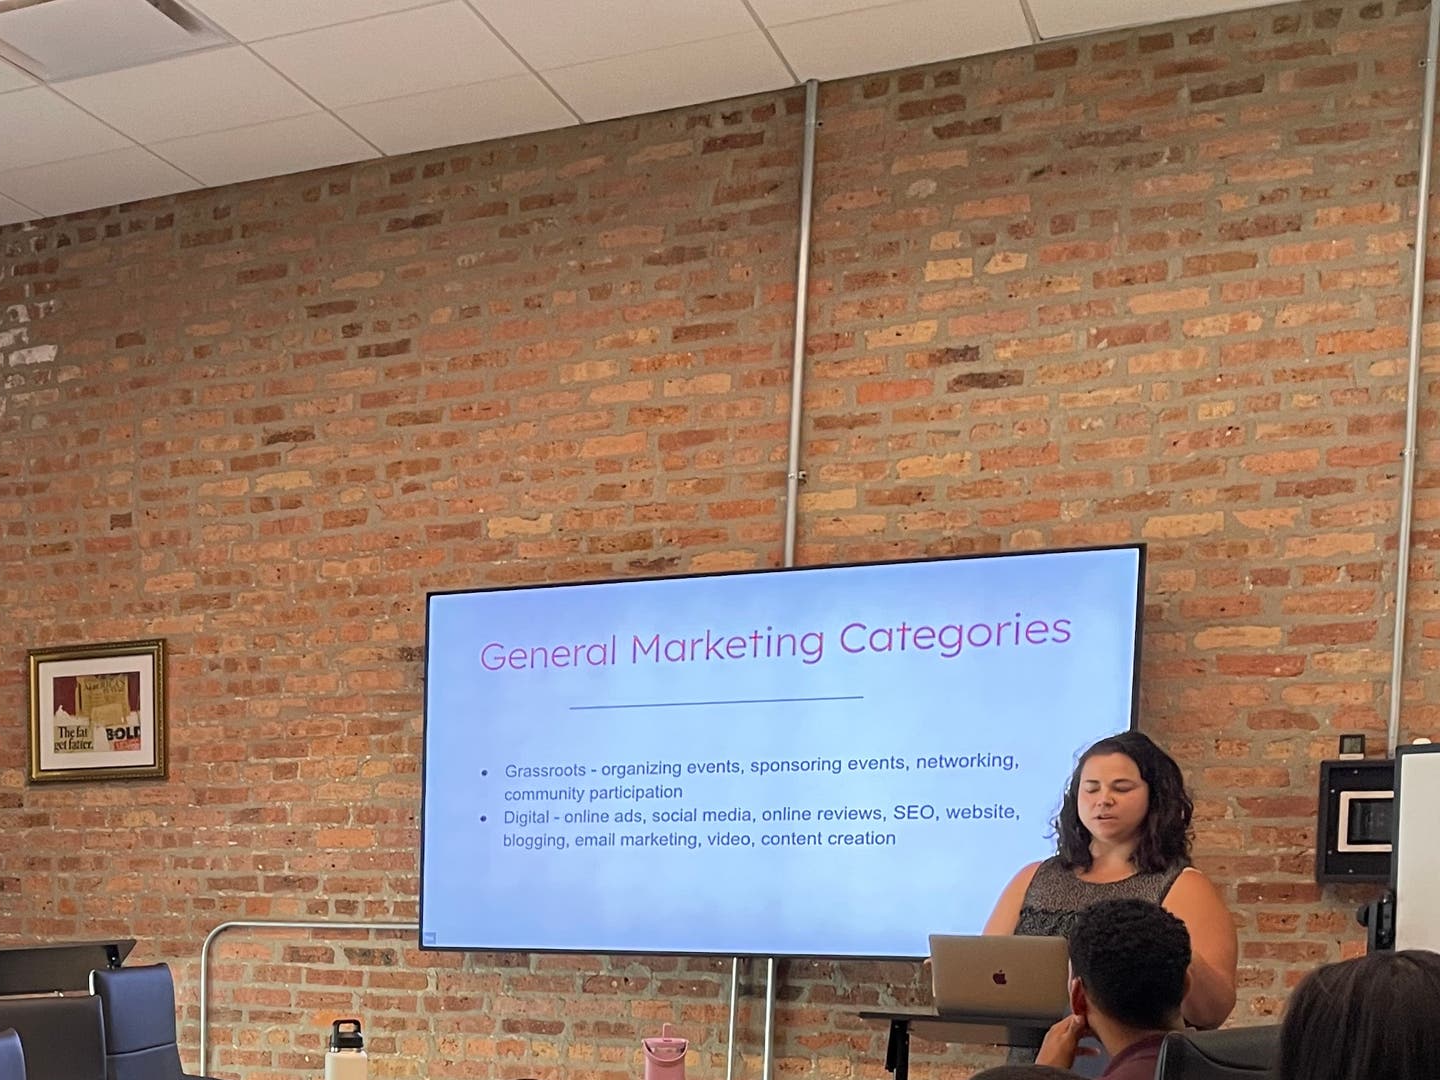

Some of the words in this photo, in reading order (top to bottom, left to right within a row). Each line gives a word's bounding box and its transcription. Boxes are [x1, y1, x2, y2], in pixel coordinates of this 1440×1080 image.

[480, 633, 617, 672] General
[631, 625, 825, 666] Marketing
[839, 611, 1072, 659] Categories
[58, 726, 75, 738] The
[76, 726, 88, 738] fat
[505, 763, 587, 778] Grassroots
[601, 760, 682, 780] organizing
[686, 759, 745, 775] events,
[750, 756, 842, 776] sponsoring
[847, 755, 910, 772] events,
[916, 752, 1019, 771] networking,
[504, 786, 585, 804] community
[589, 784, 683, 803] participation
[504, 810, 550, 828] Digital
[564, 809, 610, 824] online
[614, 808, 647, 825] ads,
[652, 807, 697, 823] social
[702, 807, 757, 824] media,
[761, 806, 812, 822] online
[817, 805, 887, 823] reviews,
[893, 804, 940, 822] SEO,
[945, 803, 1020, 821] website,
[503, 833, 570, 850] blogging,
[574, 832, 616, 847] email
[620, 831, 702, 850] marketing,
[707, 831, 756, 848] video,
[760, 831, 823, 846] content
[827, 830, 896, 846] creation
